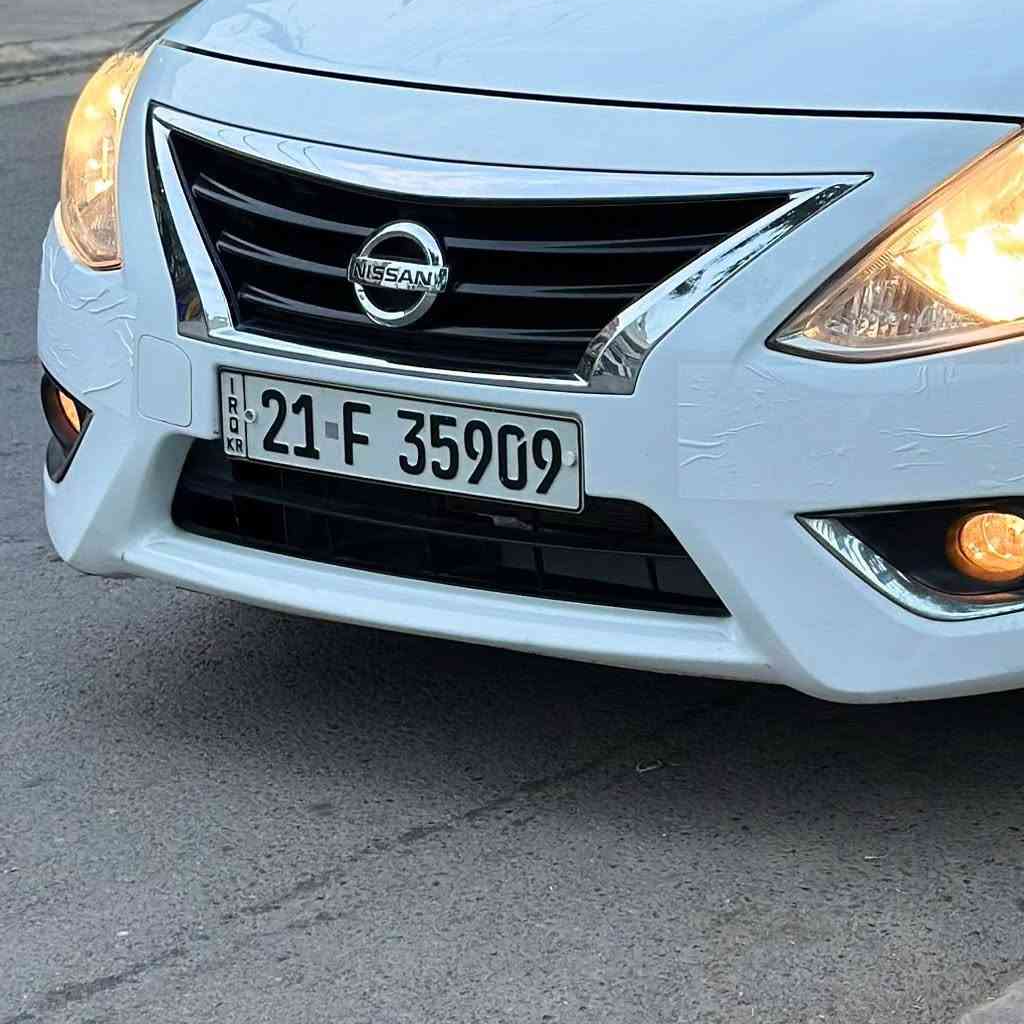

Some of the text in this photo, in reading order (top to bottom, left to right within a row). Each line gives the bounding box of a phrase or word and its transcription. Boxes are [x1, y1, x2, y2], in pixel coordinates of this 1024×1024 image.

[353, 261, 432, 285] NISSAN
[227, 437, 243, 453] KR
[261, 389, 562, 494] 21 F 35909
